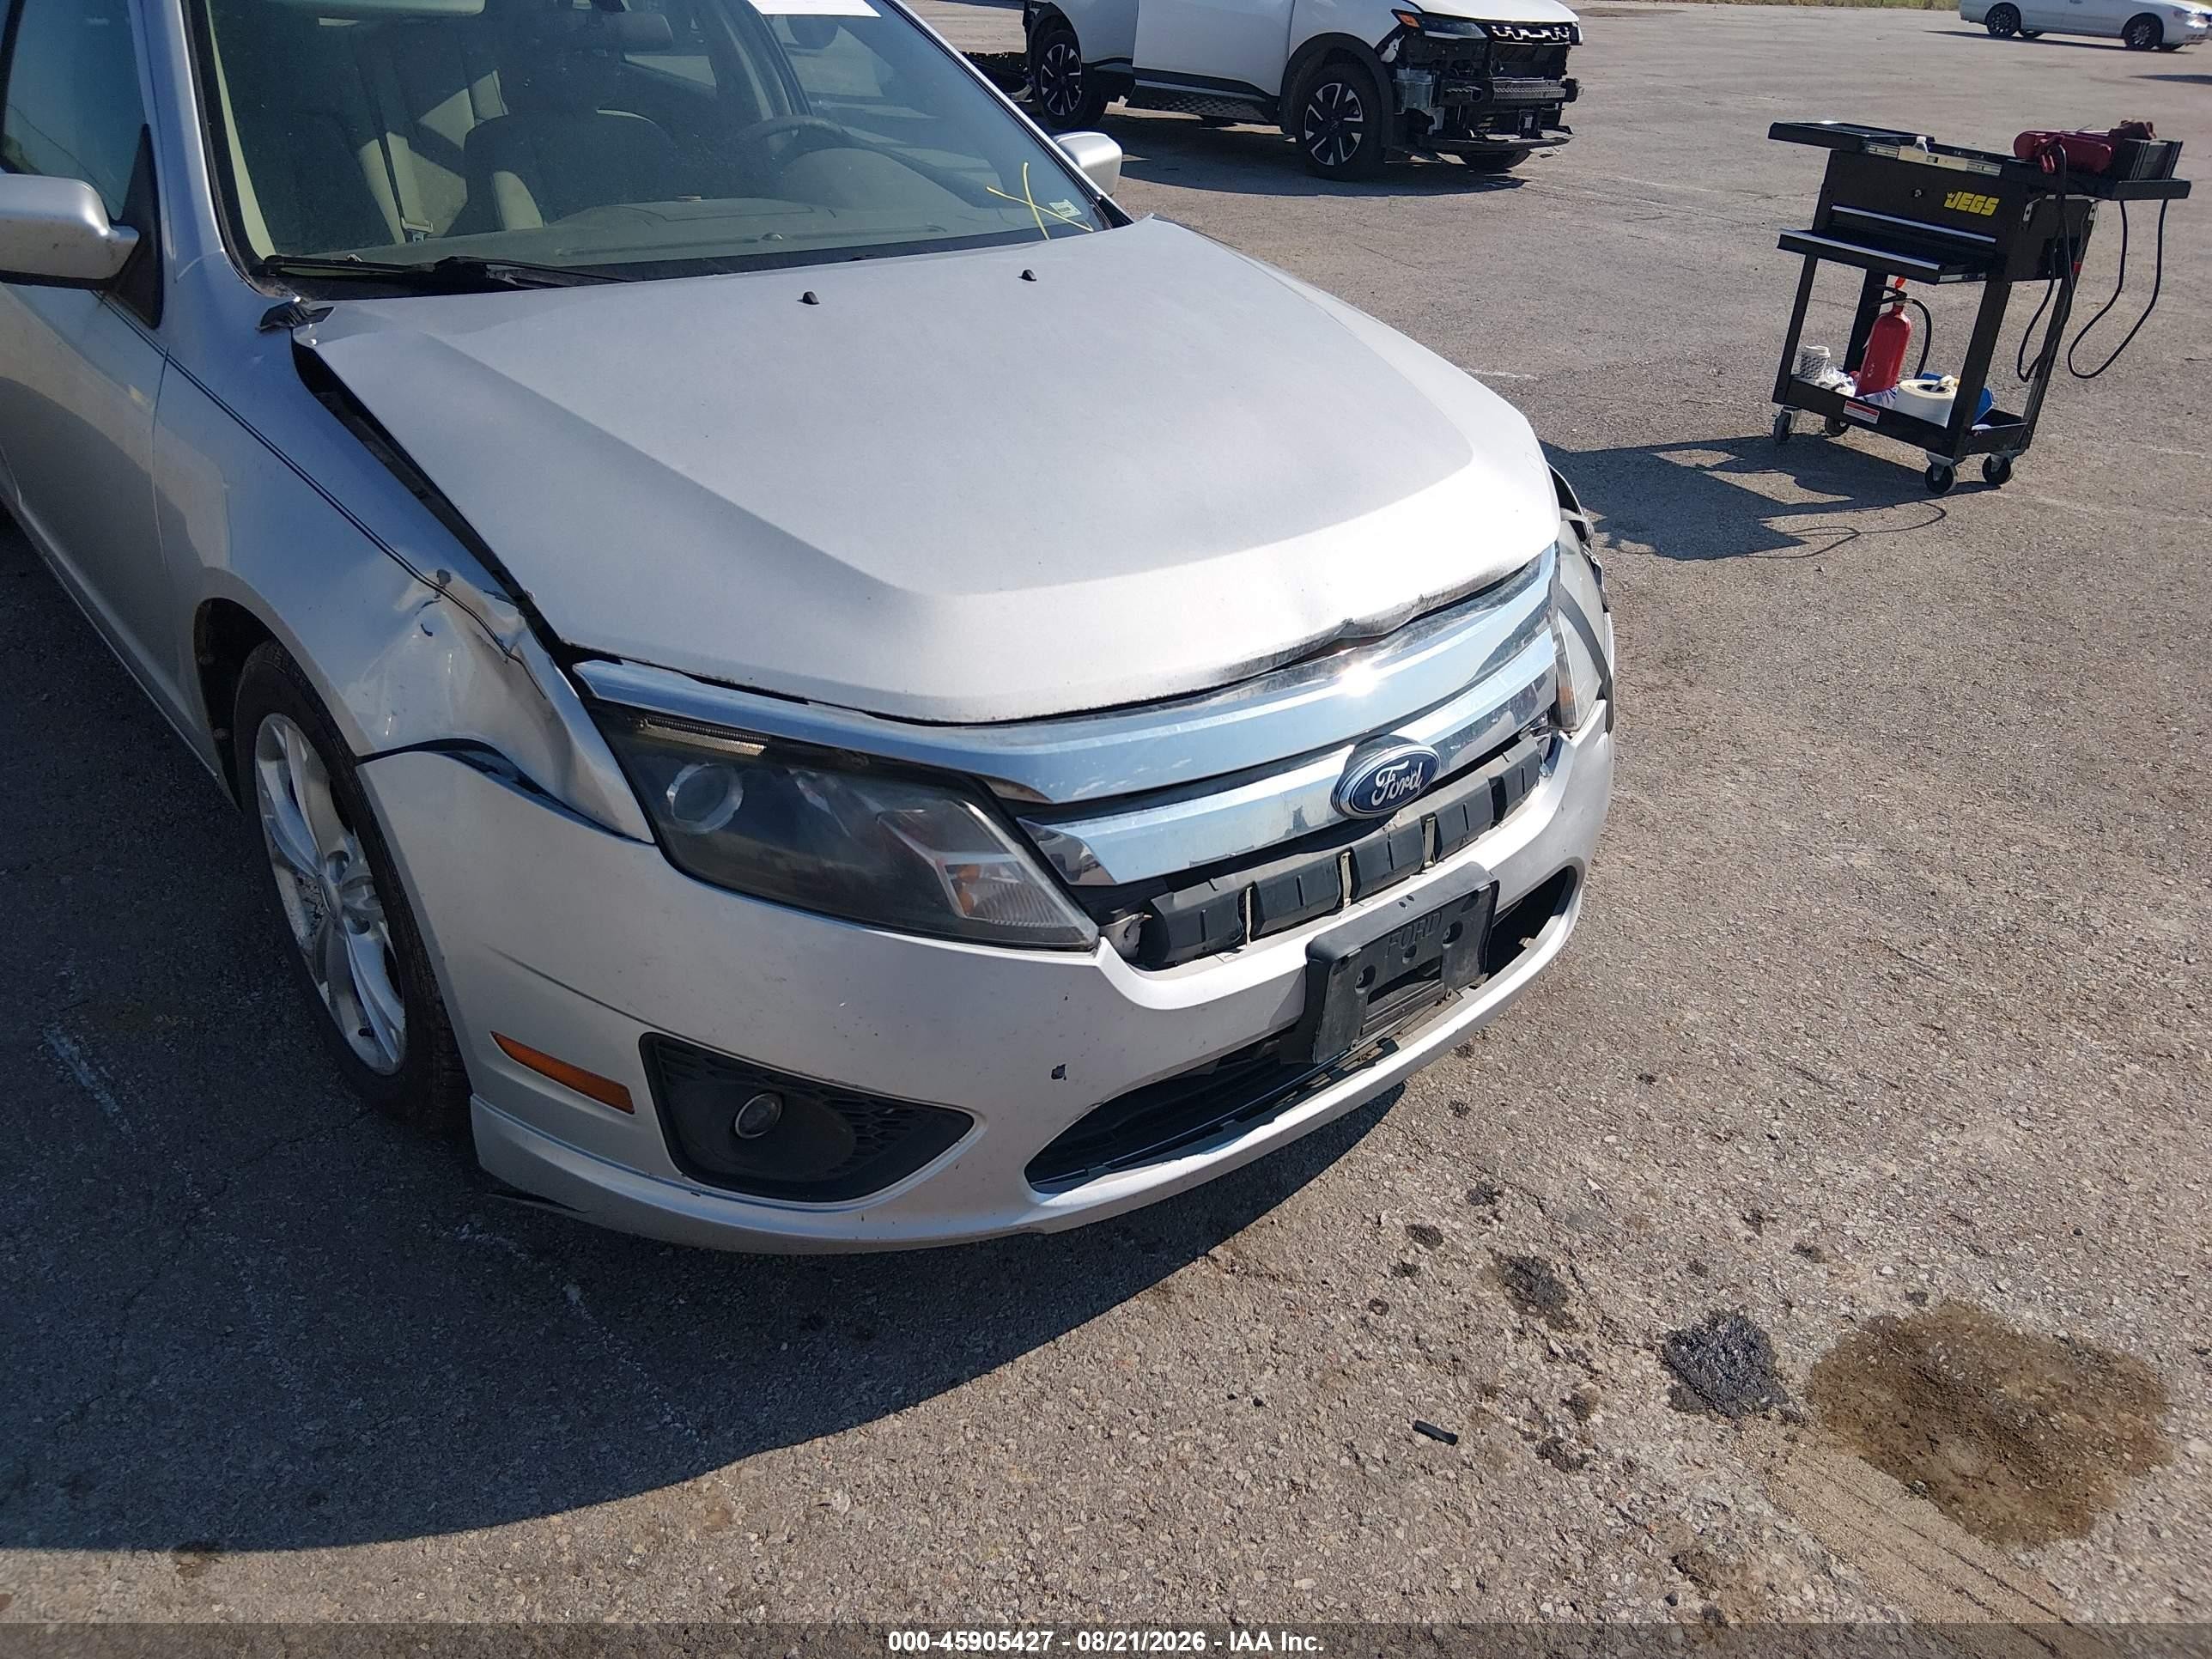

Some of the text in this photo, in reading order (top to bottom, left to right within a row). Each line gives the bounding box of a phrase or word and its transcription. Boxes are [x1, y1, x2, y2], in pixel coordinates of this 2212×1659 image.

[1943, 191, 2000, 216] JEGS
[1370, 760, 1424, 806] Ford
[1383, 911, 1442, 958] FORD
